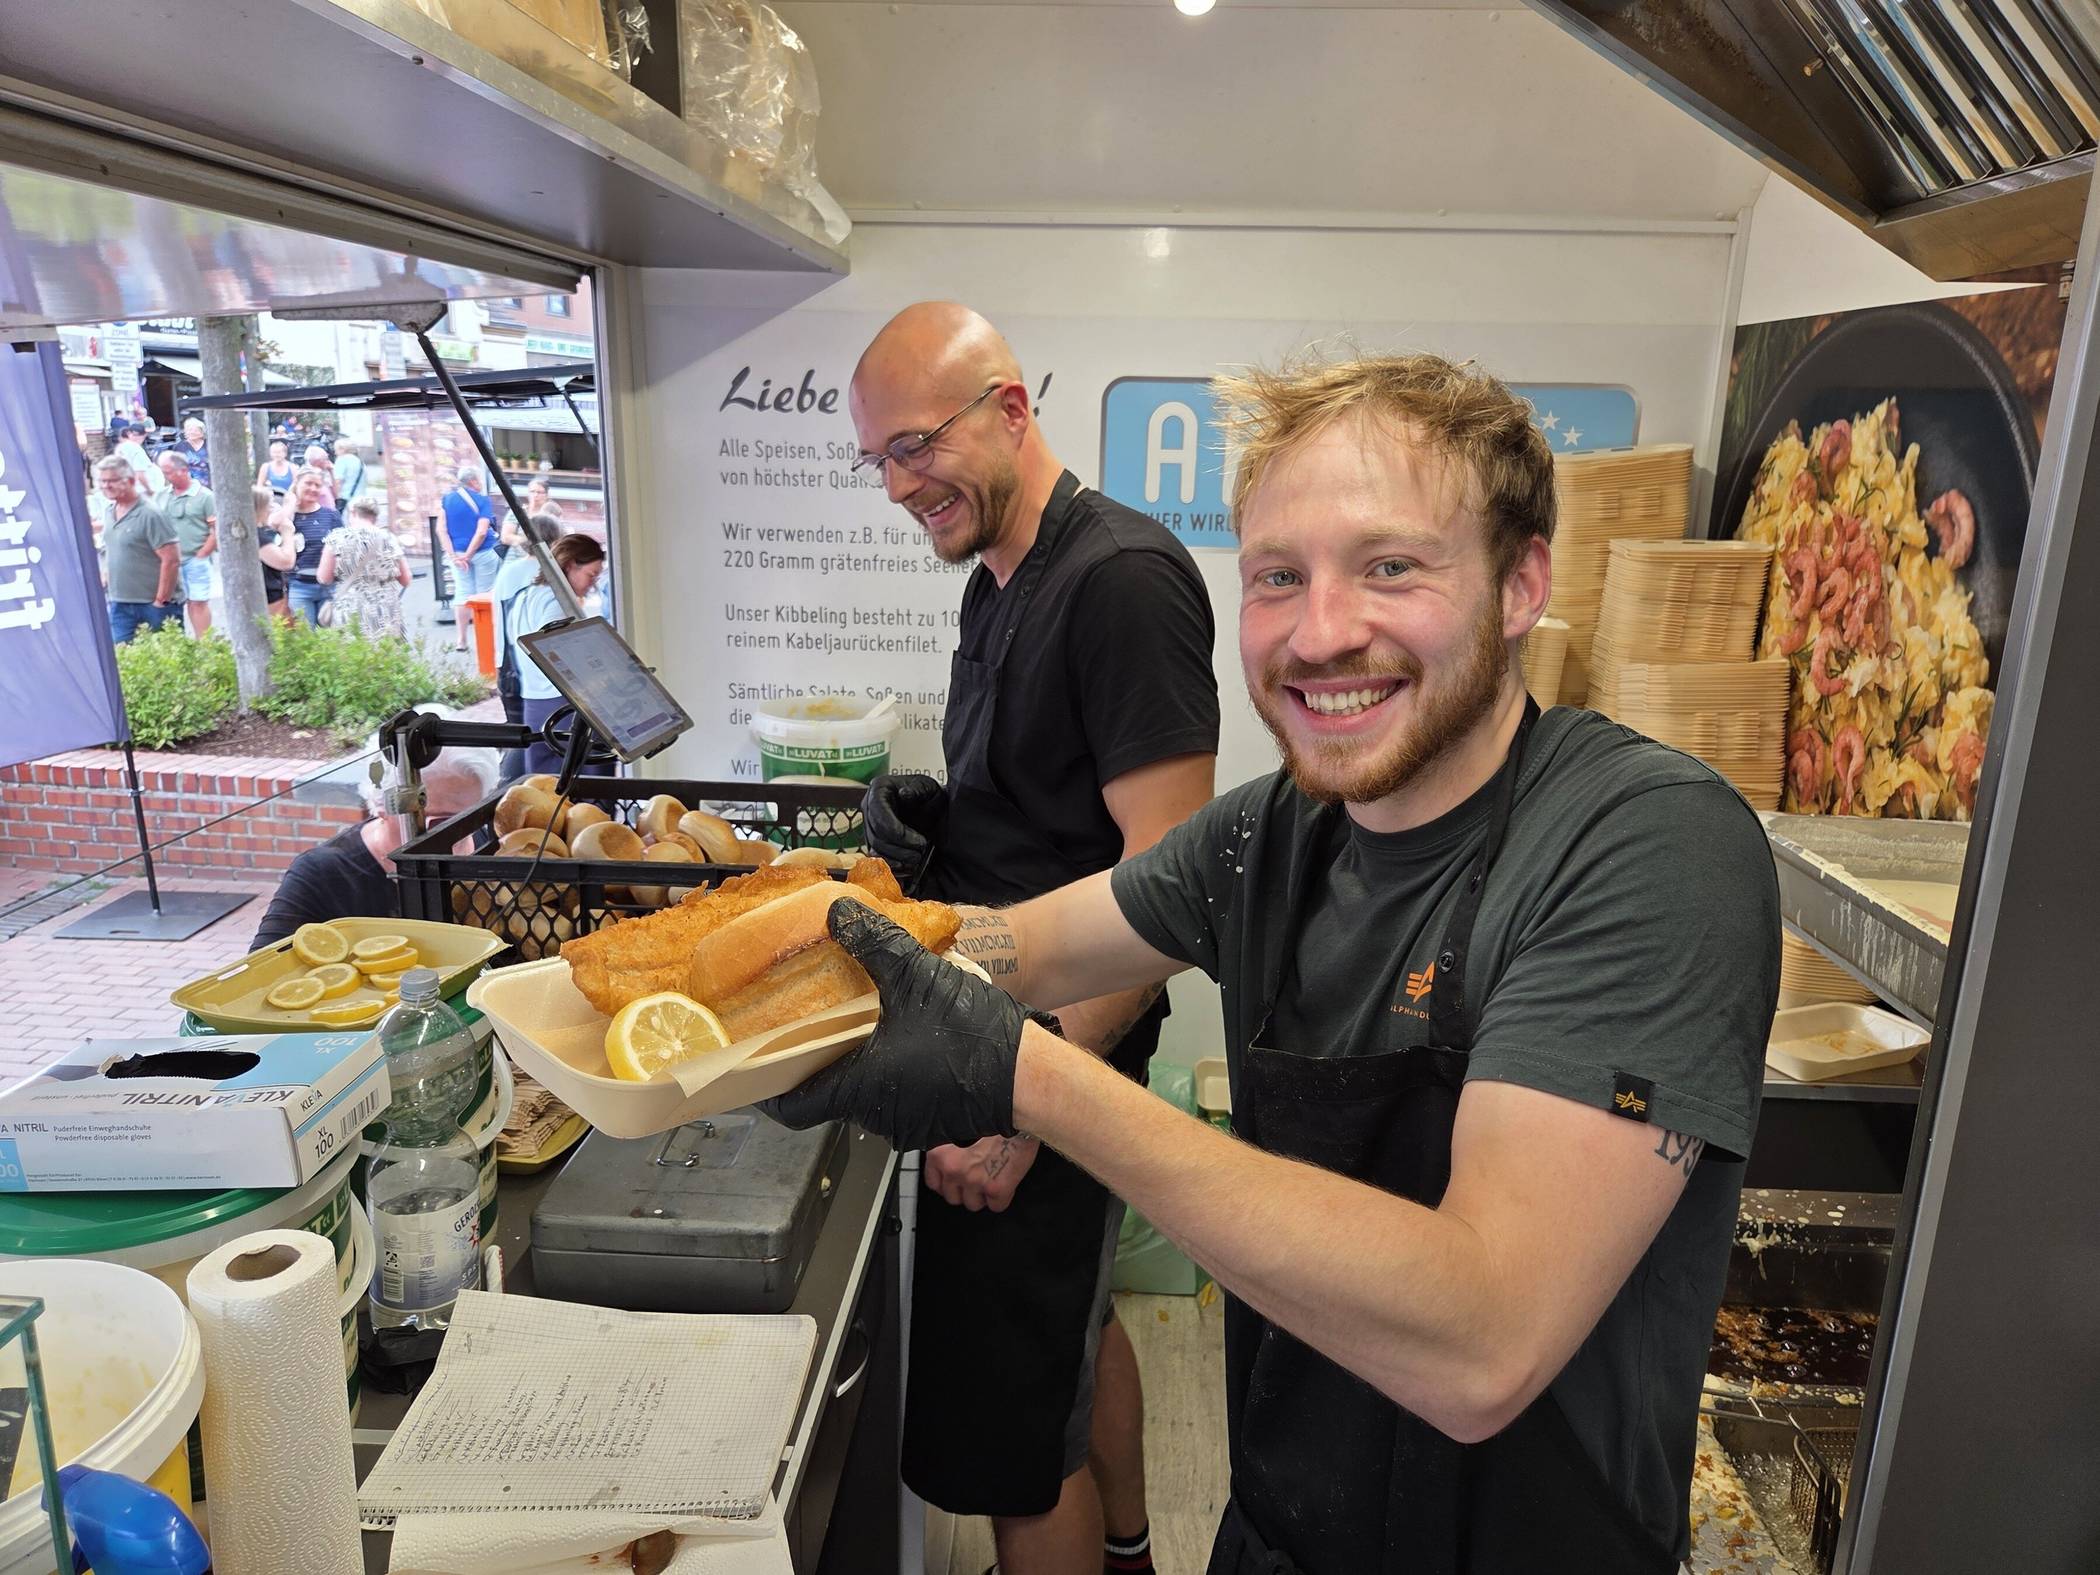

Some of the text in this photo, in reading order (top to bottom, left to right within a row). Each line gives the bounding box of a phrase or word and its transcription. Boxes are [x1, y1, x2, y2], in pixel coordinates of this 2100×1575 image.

[719, 366, 839, 414] Liebe
[719, 439, 862, 463] Alle Speisen, Soß
[720, 471, 748, 486] von
[753, 467, 824, 488] höchster
[722, 522, 752, 541] Wir
[757, 524, 844, 544] verwenden
[849, 526, 877, 545] z.B.
[883, 526, 908, 545] für
[723, 550, 754, 568] 220
[759, 551, 815, 570] Gramm
[820, 553, 918, 575] grätenfreies
[725, 603, 961, 629] Unser Kibbeling besteht zu 10
[727, 631, 942, 655] reinem Kabeljaurückenfilet.
[728, 682, 804, 700] Sämtliche
[918, 688, 945, 705] und
[729, 707, 753, 725] die
[731, 759, 760, 776] Wir
[122, 1093, 209, 1106] NITRIL
[214, 1090, 295, 1106] KLEVA
[300, 1089, 323, 1112] KLEVA
[14, 1123, 49, 1132] NITRIL
[53, 1124, 88, 1133] Puderfreie
[88, 1124, 151, 1133] Einweghandschuhe
[55, 1133, 152, 1142] Powderfree disposable gloves
[317, 1126, 328, 1138] XL
[315, 1133, 334, 1158] 100
